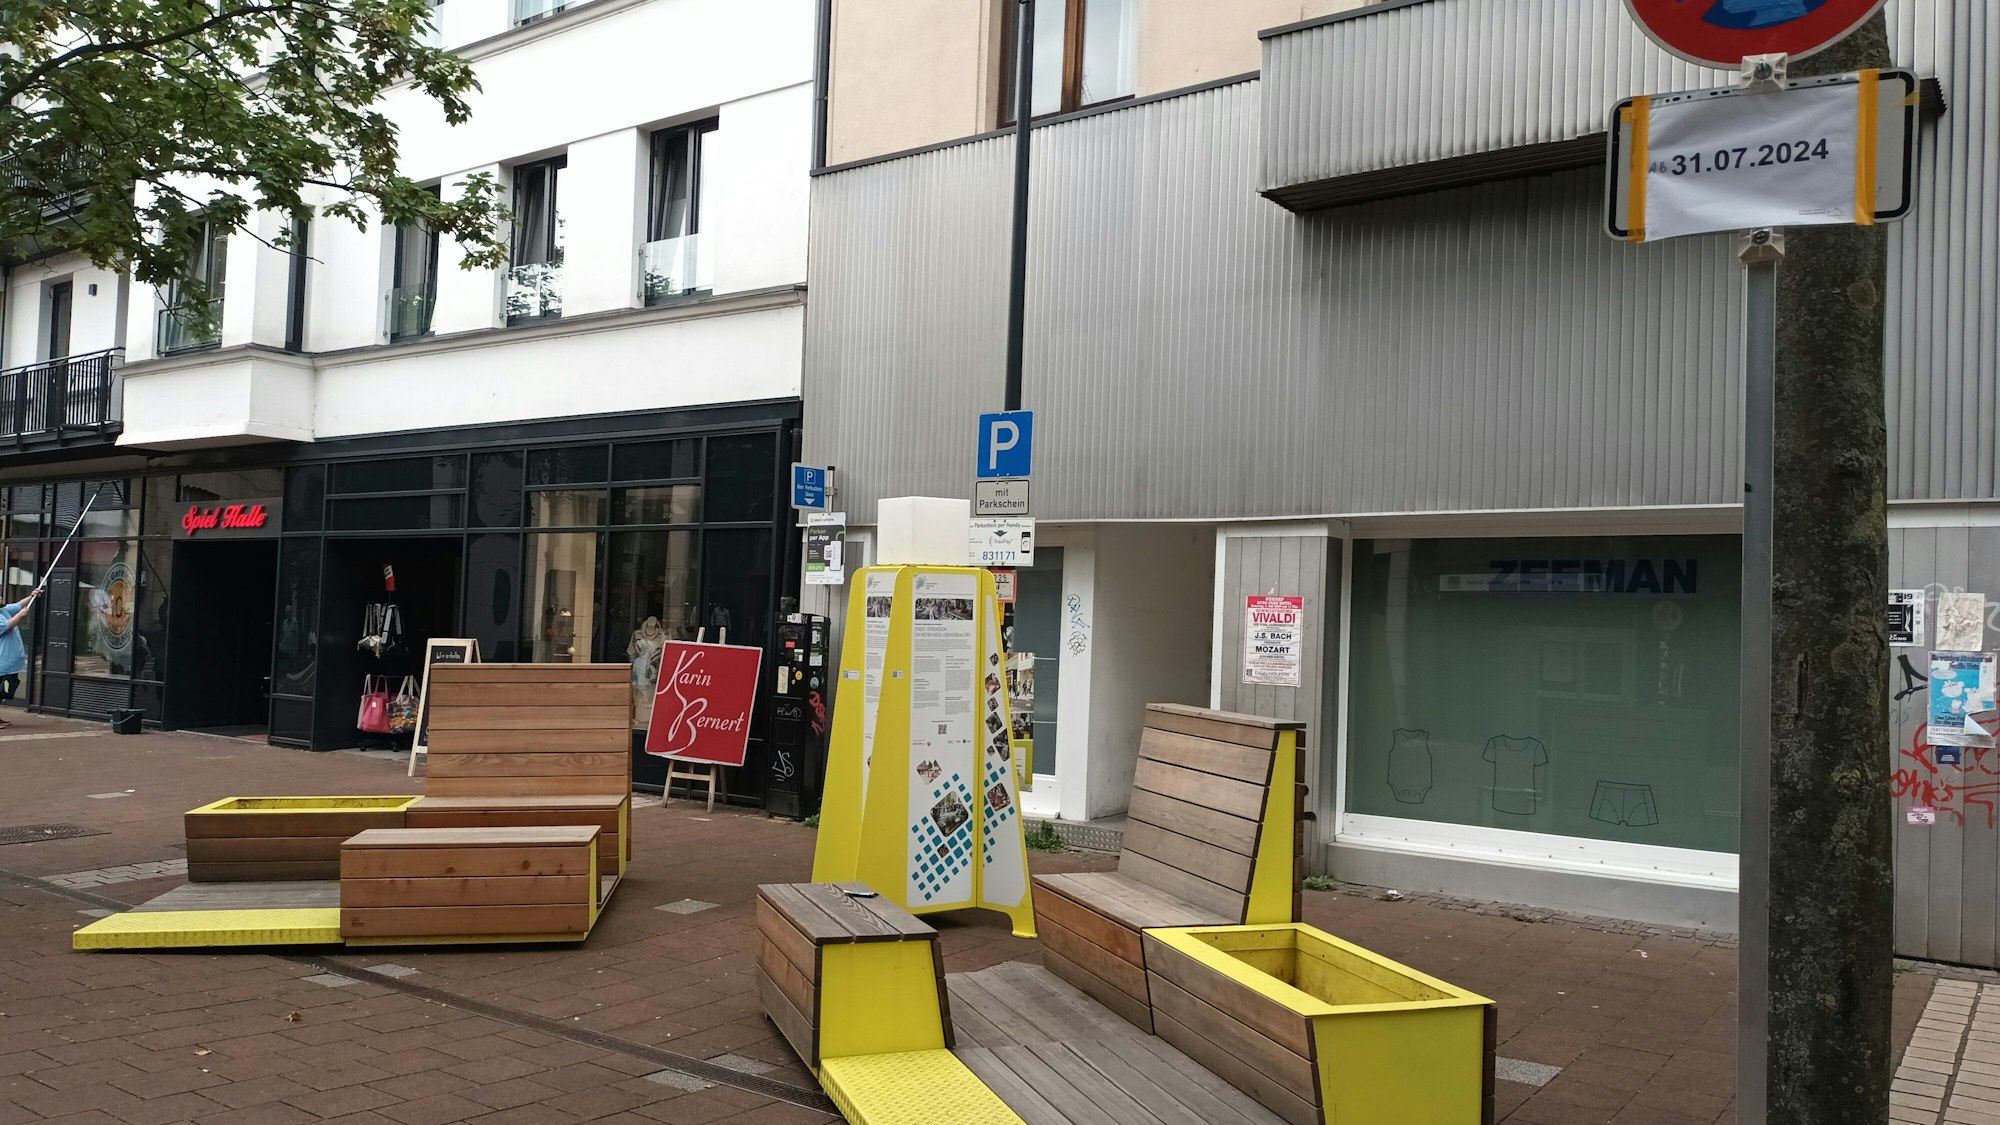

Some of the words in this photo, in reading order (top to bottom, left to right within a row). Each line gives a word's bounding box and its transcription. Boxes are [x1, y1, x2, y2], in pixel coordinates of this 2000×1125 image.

[1671, 138, 1829, 176] 31.07.2024
[989, 420, 1020, 470] P
[979, 498, 1025, 509] Parkschein
[995, 488, 1009, 497] mit
[182, 505, 222, 536] Spiel
[220, 504, 268, 528] Halle
[982, 550, 1016, 561] 831171
[1489, 559, 1698, 594] ZEEMAN
[1252, 612, 1296, 624] VIVALDI
[1270, 632, 1292, 640] BACH
[1255, 645, 1291, 654] MOZART
[656, 649, 711, 695] Karin
[668, 697, 745, 748] Bernert
